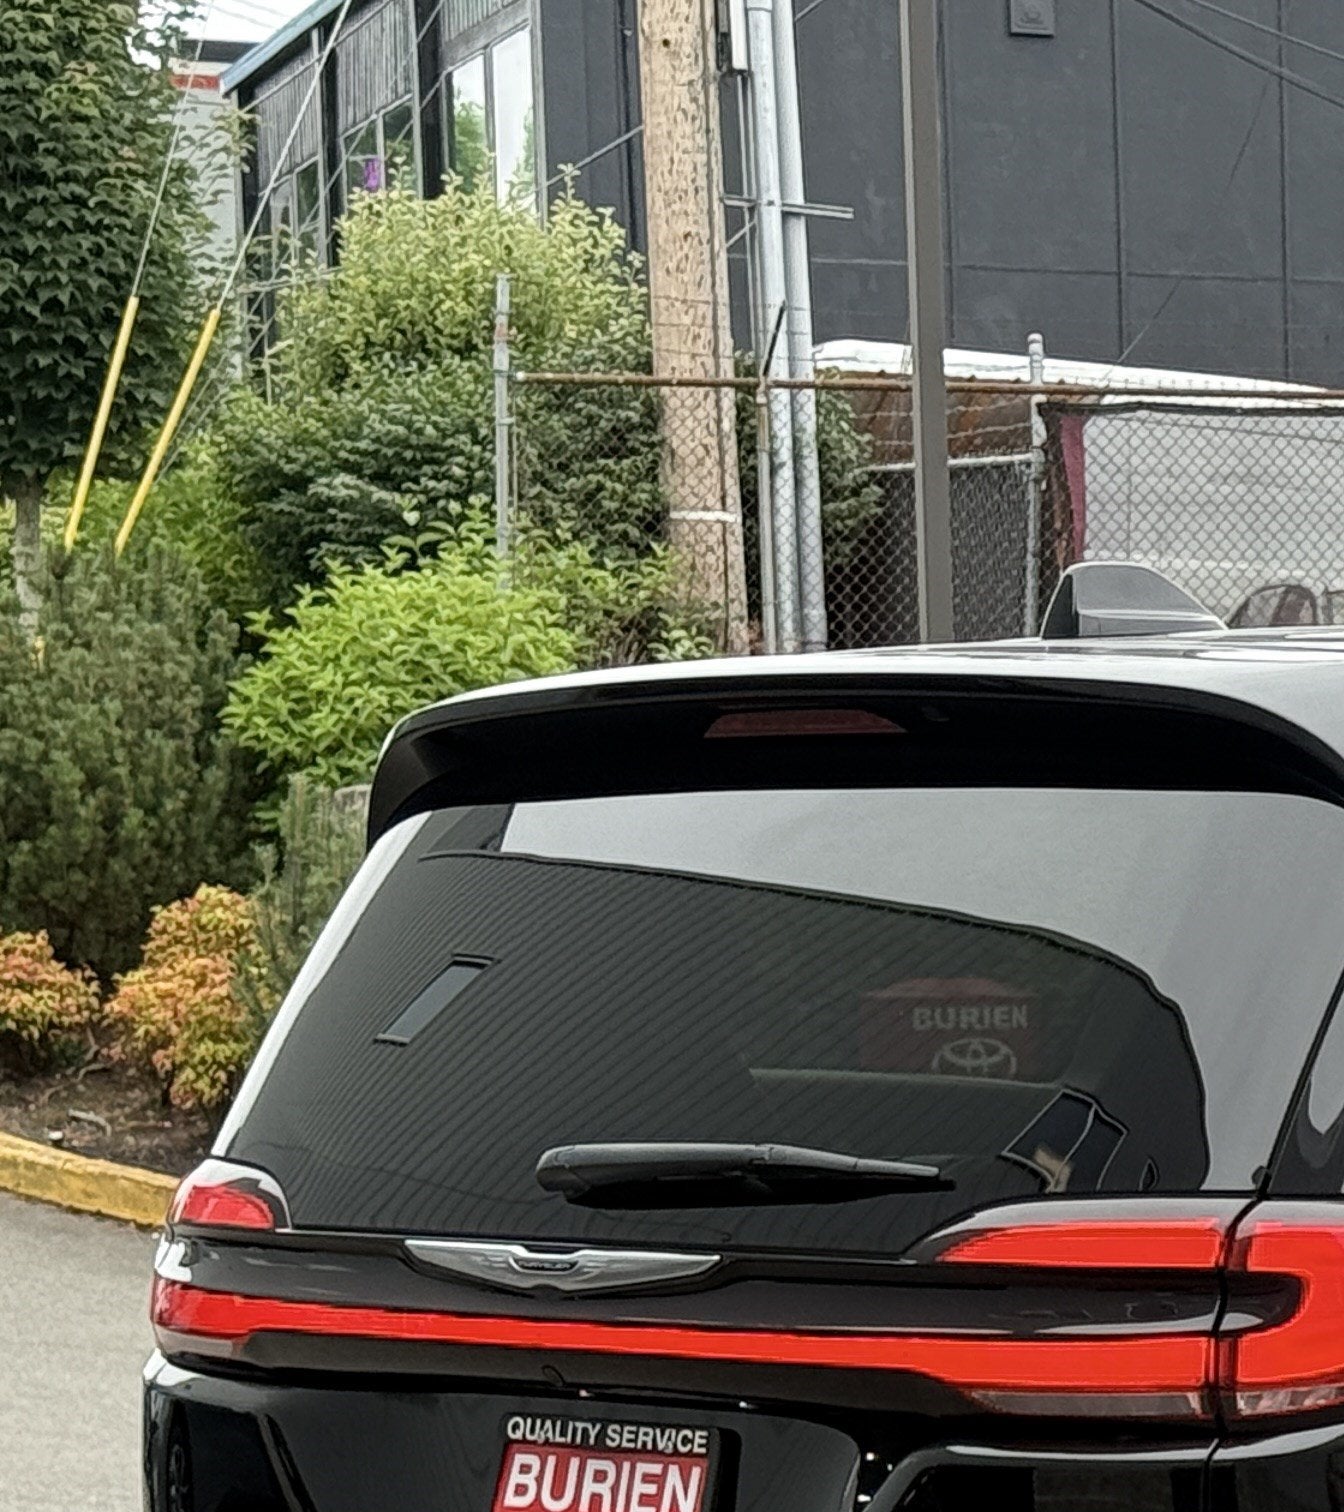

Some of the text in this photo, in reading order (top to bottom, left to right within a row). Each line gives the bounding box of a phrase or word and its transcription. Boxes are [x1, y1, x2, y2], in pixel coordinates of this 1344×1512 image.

[911, 1004, 1029, 1031] BURIEN
[507, 1416, 709, 1454] QUALITY SERVICE
